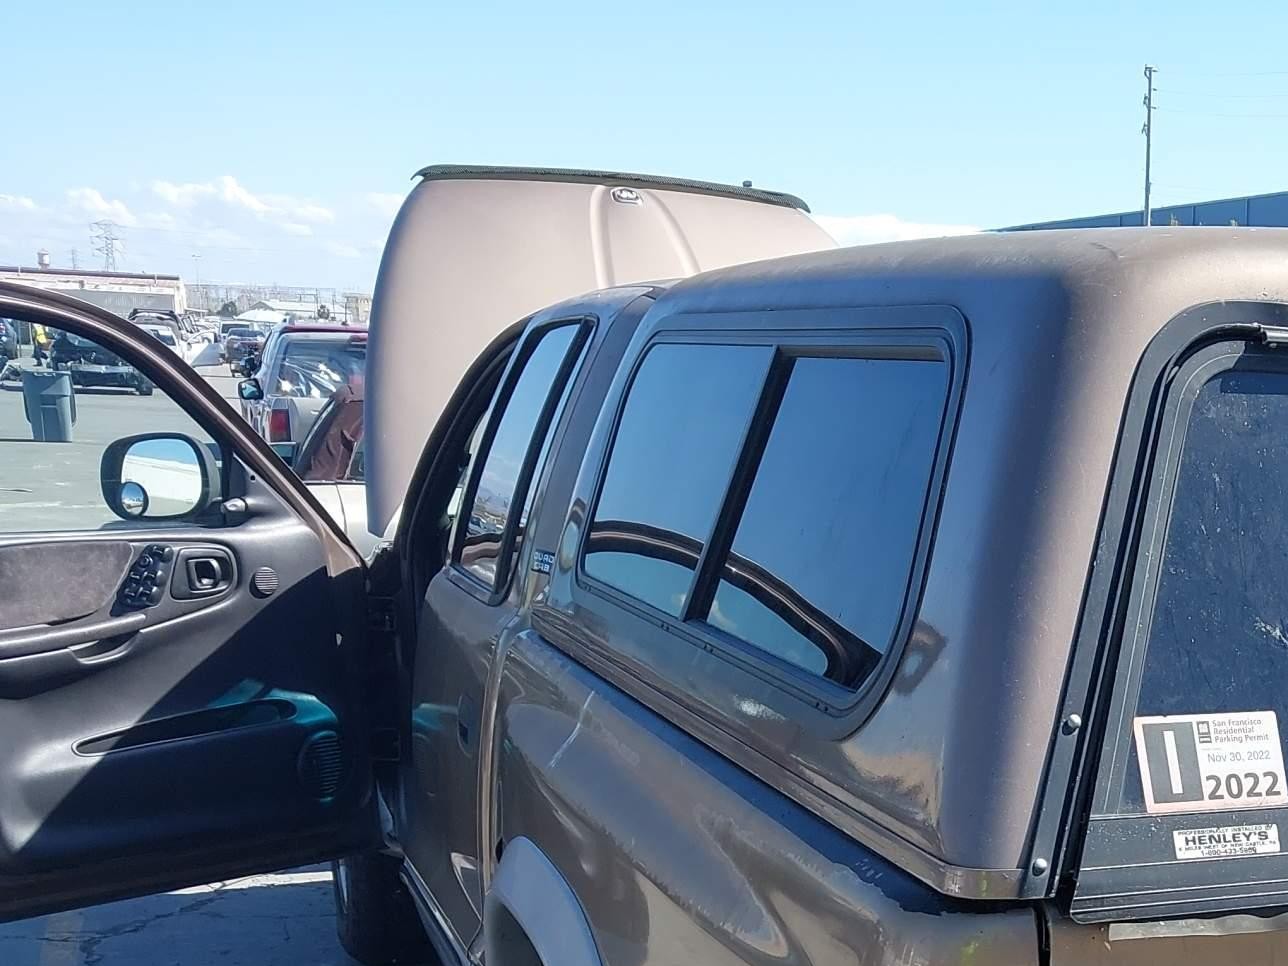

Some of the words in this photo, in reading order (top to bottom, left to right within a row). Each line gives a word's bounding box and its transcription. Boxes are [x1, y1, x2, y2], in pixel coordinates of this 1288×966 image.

[1212, 719, 1226, 728] San
[1228, 718, 1262, 727] Francisco
[1213, 726, 1255, 735] Residential
[1214, 734, 1244, 744] Parking
[1245, 734, 1269, 742] Permit
[1207, 752, 1227, 763] Nov
[1247, 750, 1271, 761] 2022
[1205, 771, 1281, 801] 2022
[1185, 830, 1269, 846] HENLEY'S
